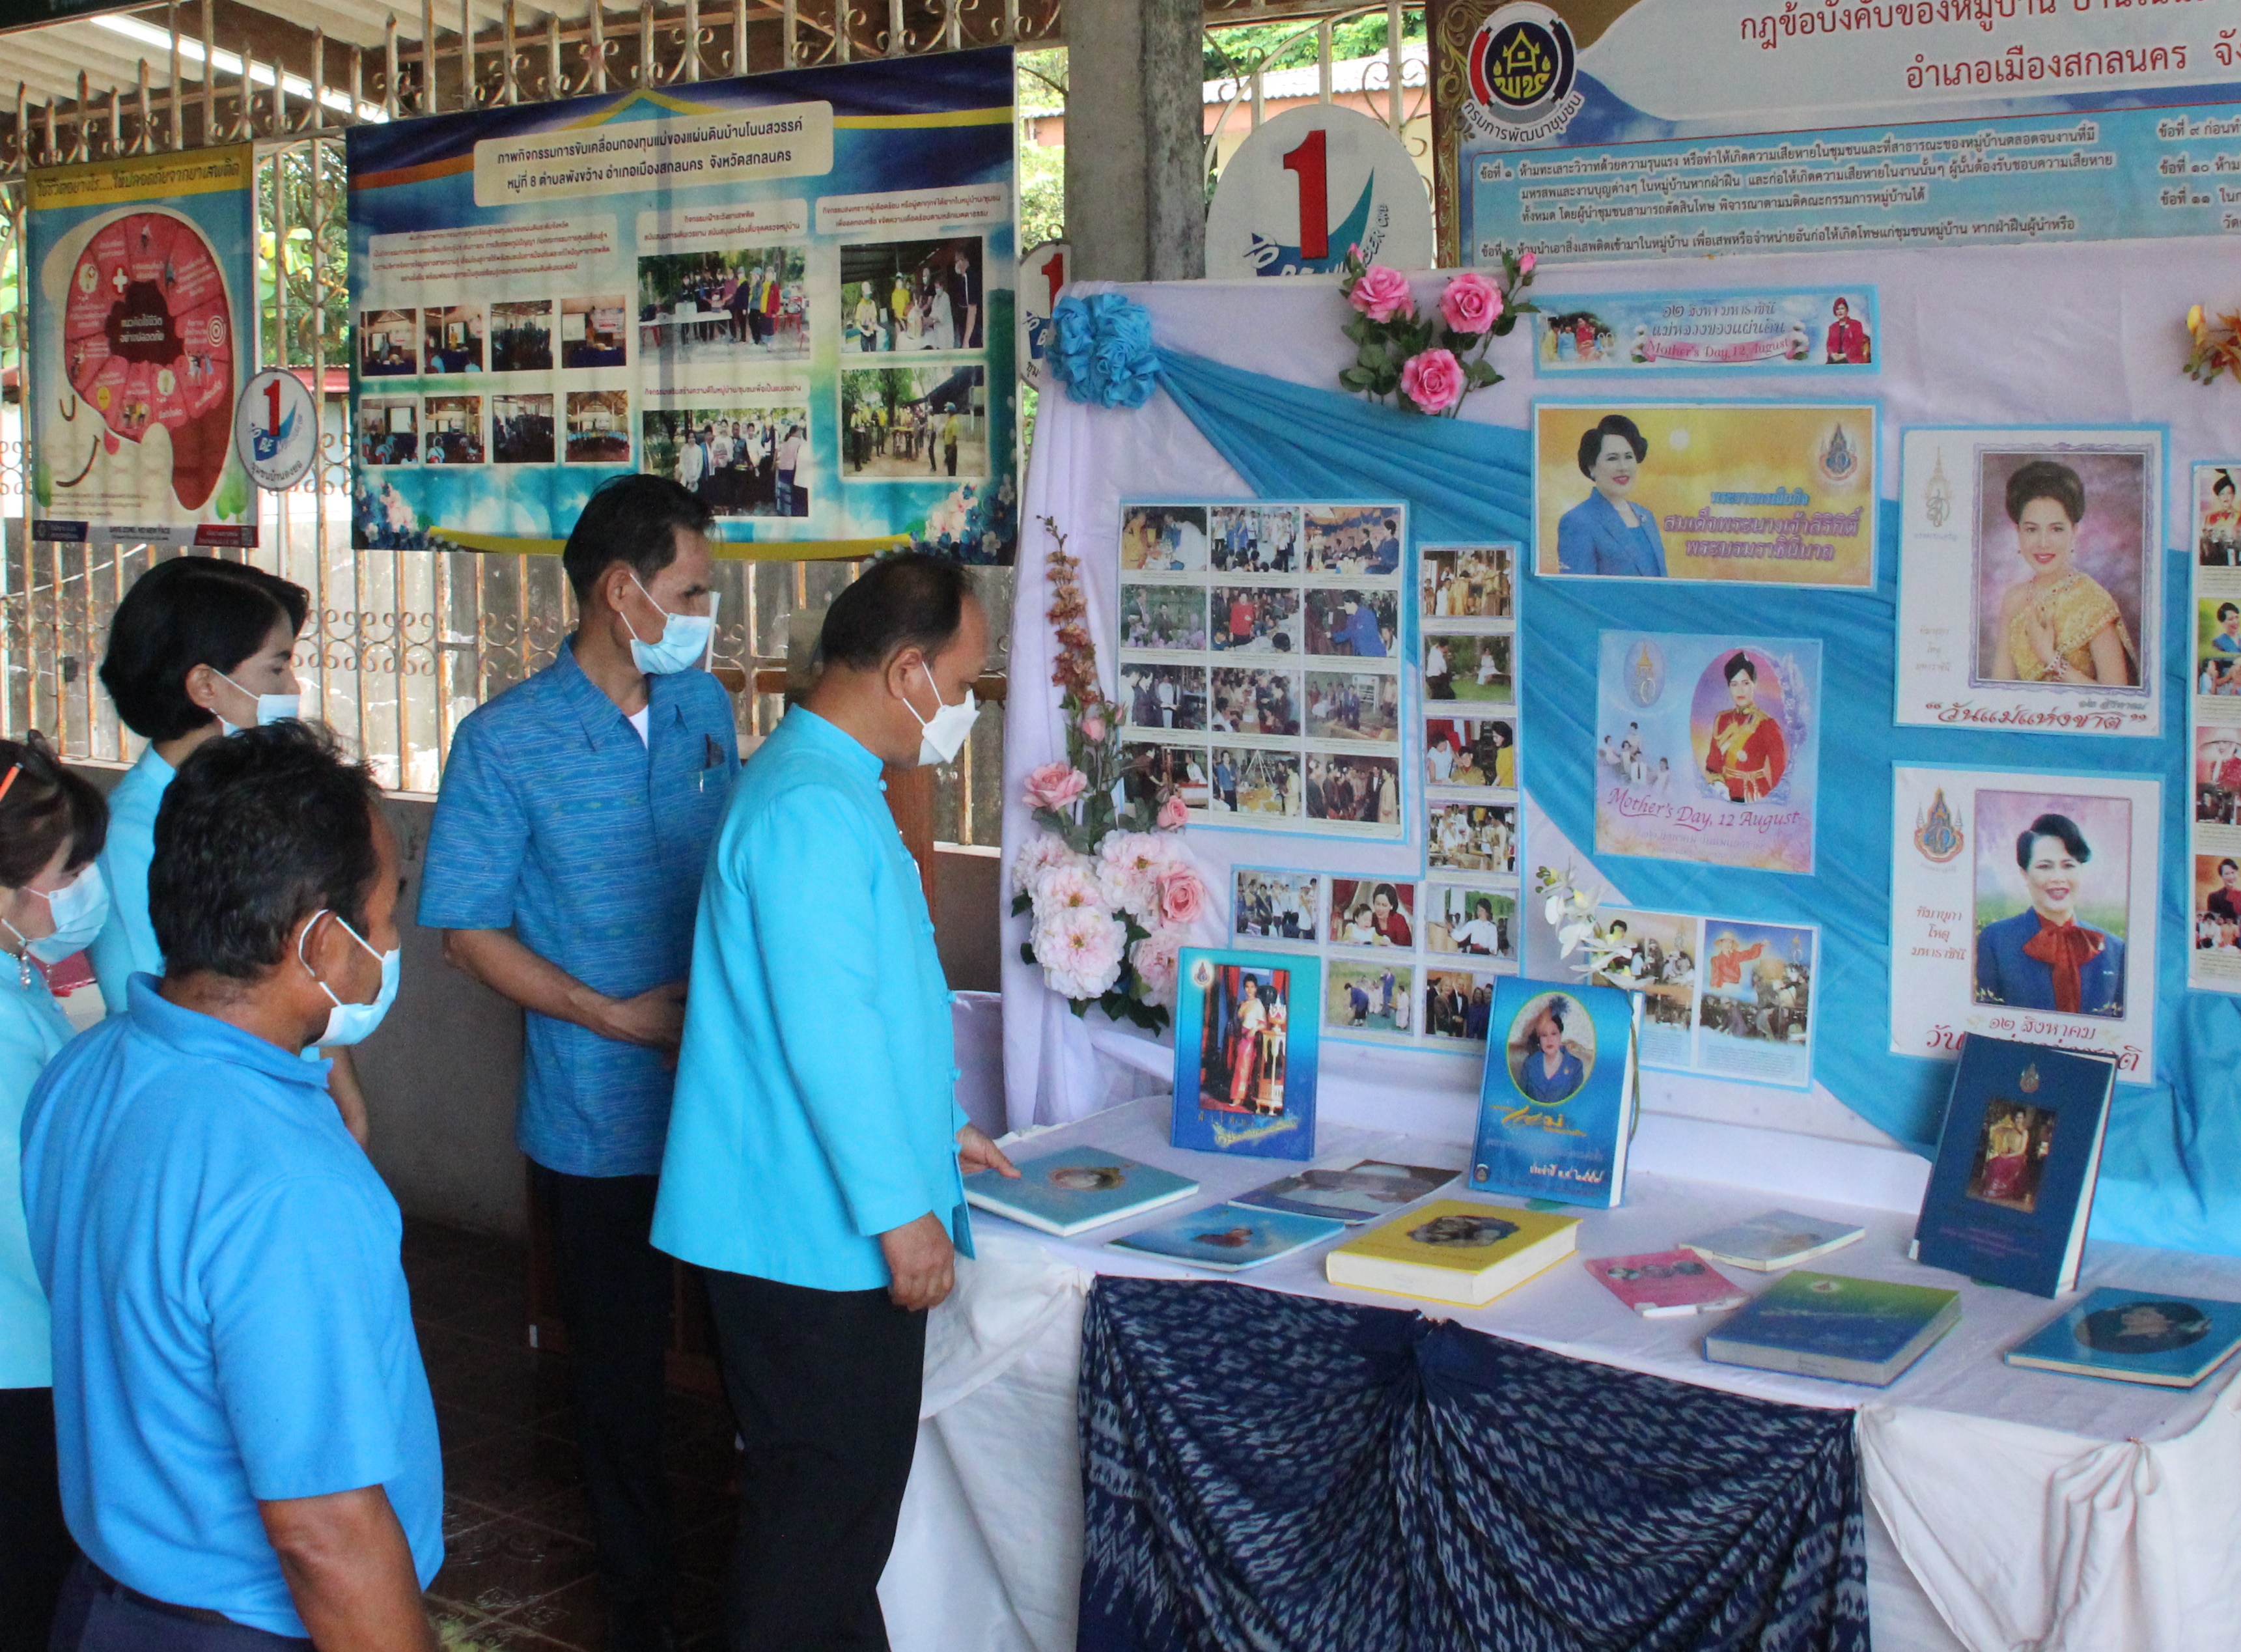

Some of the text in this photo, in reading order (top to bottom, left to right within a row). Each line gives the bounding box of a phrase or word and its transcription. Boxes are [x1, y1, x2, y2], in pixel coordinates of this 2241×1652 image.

[1906, 44, 2187, 89] อำเภอเมืองสกลนคร
[1464, 94, 1582, 142] กรมการพัฒนาชุมชน
[2159, 119, 2184, 137] ข้อที่
[498, 116, 803, 163] ภาพกิจกรรมการขับเคลื่อนกองทุนแม่ของแผ่นดินบ้านโนนสวรรค์
[1481, 162, 1501, 179] ข้อที่
[1520, 157, 1678, 176] ห้ามทะเลาะวิวาทด้วยความรุนแรง
[1683, 123, 2095, 165] หรือทำให้เกิดความเสียหายในชุมชนและที่สาธารณะของหมู่บ้านตลอดจนงานที่มี
[508, 150, 791, 193] หมู่ที่ 8 ตำบลพังขว้าง อำเภอเมืองสกลนคร จังหวัดสกลนคร
[1522, 152, 2113, 199] มหรสพและงานบุญต่างๆ ในหมู่บ้านหากฝ่าฝืน และก่อให้เกิดความเสียหายในงานนั้นๆ ผู้นั้นต้องรับชอบความเสียหาย
[2160, 156, 2185, 175] ข้อที่
[1283, 130, 1328, 259] 1
[1522, 186, 1925, 223] ทั้งหมด โดยผู้นำชุมชนสามารถตัดสินโทษ พิจารณาตามมติคณะกรรมการหมู่บ้านได้
[2161, 186, 2186, 205] ข้อที่
[1481, 241, 1502, 257] ข้อที่
[1693, 221, 1968, 248] เพื่อเสพหรือจำหน่ายอันก่อให้เกิดโทษแก่ชุมชนหมู่บ้าน
[1973, 215, 2075, 236] หากฝ่าฝืนผู้นำหรือ
[1652, 318, 1785, 336] แม่หลวงของแผ่นดิน
[1648, 340, 1699, 357] Mother's
[264, 379, 281, 436] 1
[1663, 506, 1863, 537] สมเด็จพระนางเจ้าสิริกิติ์
[1685, 533, 1836, 561] พระบรมราชินีนาถ
[1607, 787, 1801, 833] Mother's Day, 12 August
[1989, 1015, 2096, 1040] ๑๒ สิงหาคม
